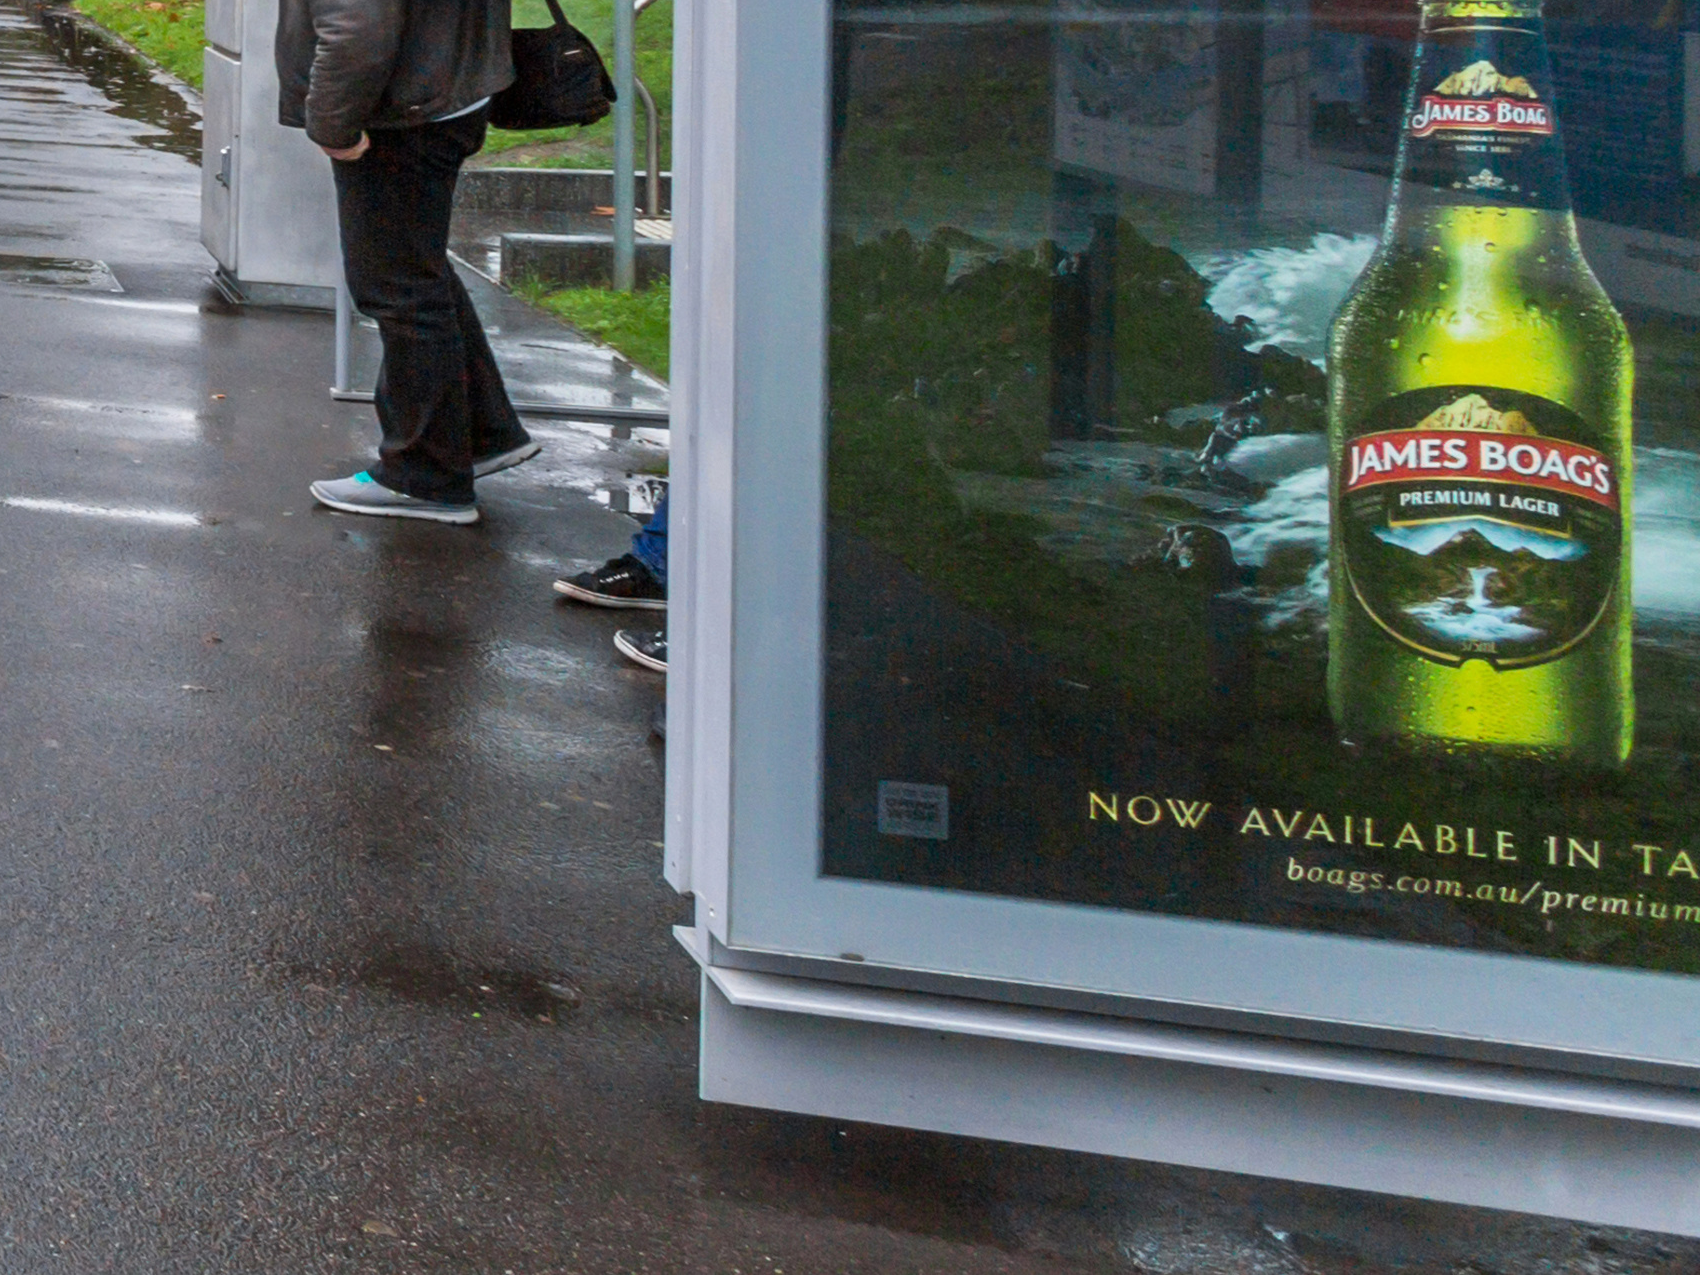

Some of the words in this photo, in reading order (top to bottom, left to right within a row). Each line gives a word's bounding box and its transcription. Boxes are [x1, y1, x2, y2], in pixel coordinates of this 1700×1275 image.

[1412, 100, 1491, 129] JAMES
[1496, 102, 1547, 125] BOAG
[1349, 438, 1469, 486] JAMES
[1478, 439, 1611, 495] BOAG'S
[1399, 490, 1492, 507] PREMIUM
[1499, 493, 1561, 517] LAGER
[1087, 791, 1212, 830] NOW
[1239, 807, 1519, 862] AVAILABLE
[1545, 835, 1602, 870] IN
[1286, 857, 1700, 923] boags.com.au/premium
